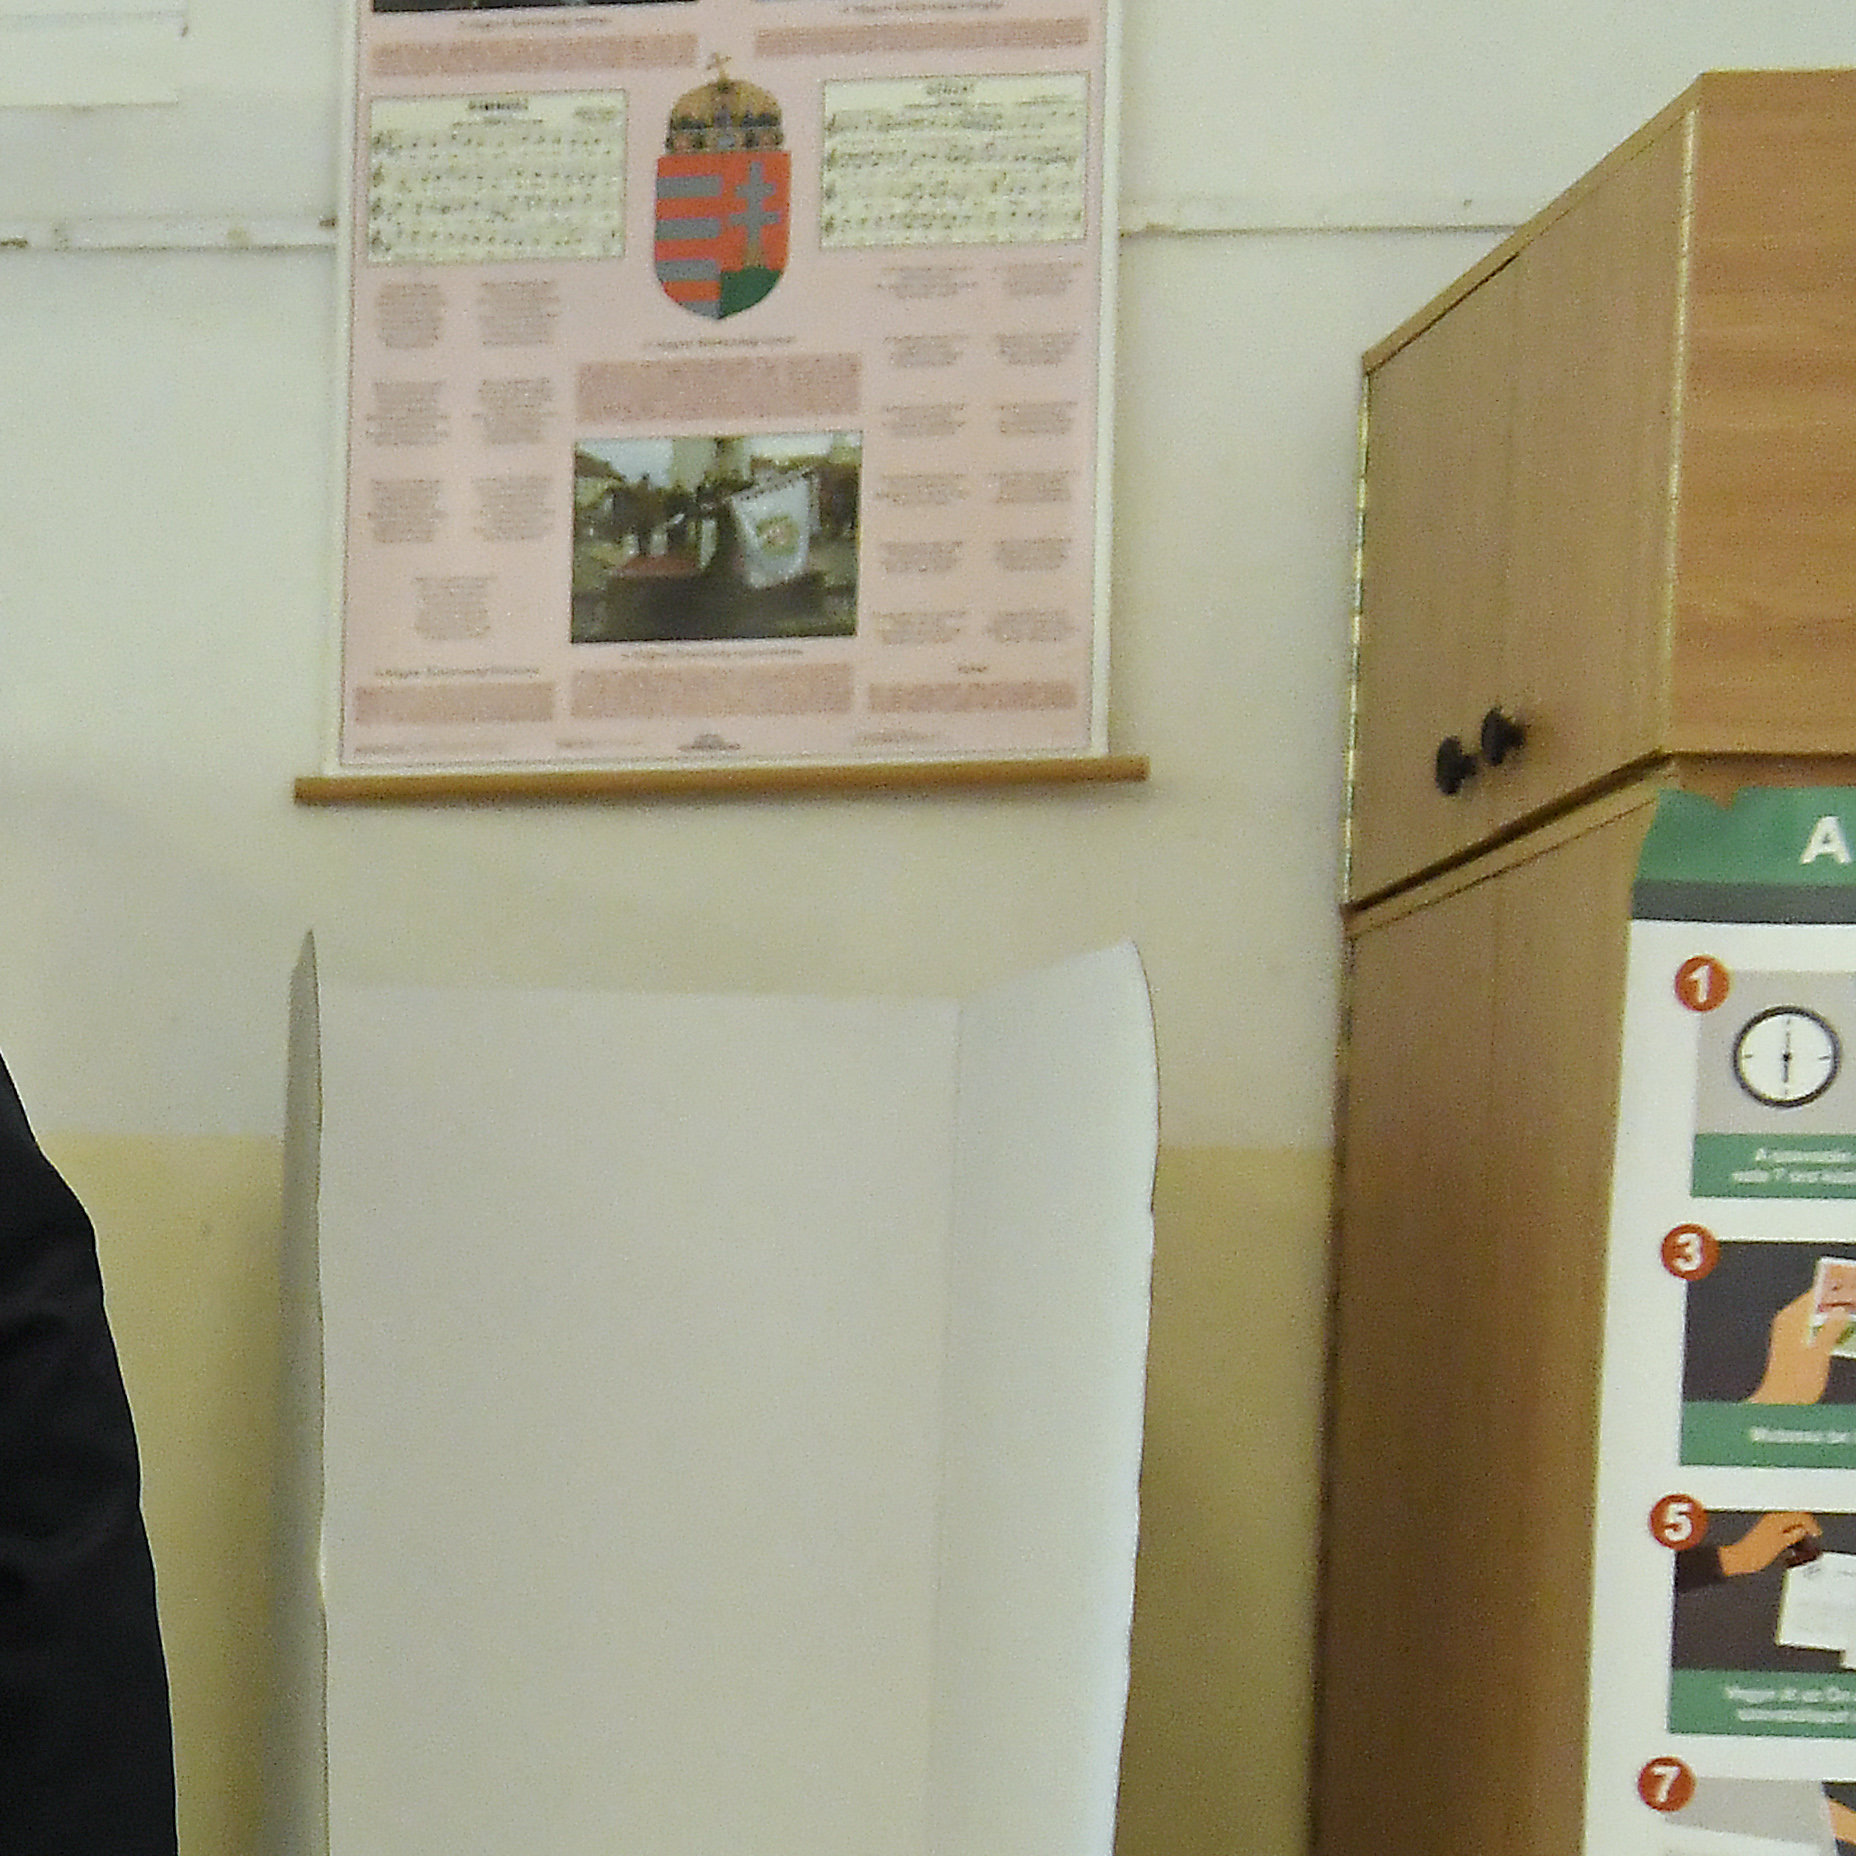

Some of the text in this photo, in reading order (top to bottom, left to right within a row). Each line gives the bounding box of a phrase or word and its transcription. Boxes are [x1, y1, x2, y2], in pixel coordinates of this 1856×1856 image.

[1800, 815, 1852, 865] A
[1690, 964, 1709, 1003] 1
[1674, 1233, 1702, 1271] 3
[1664, 1503, 1693, 1542] 5
[1650, 1766, 1681, 1802] 7
